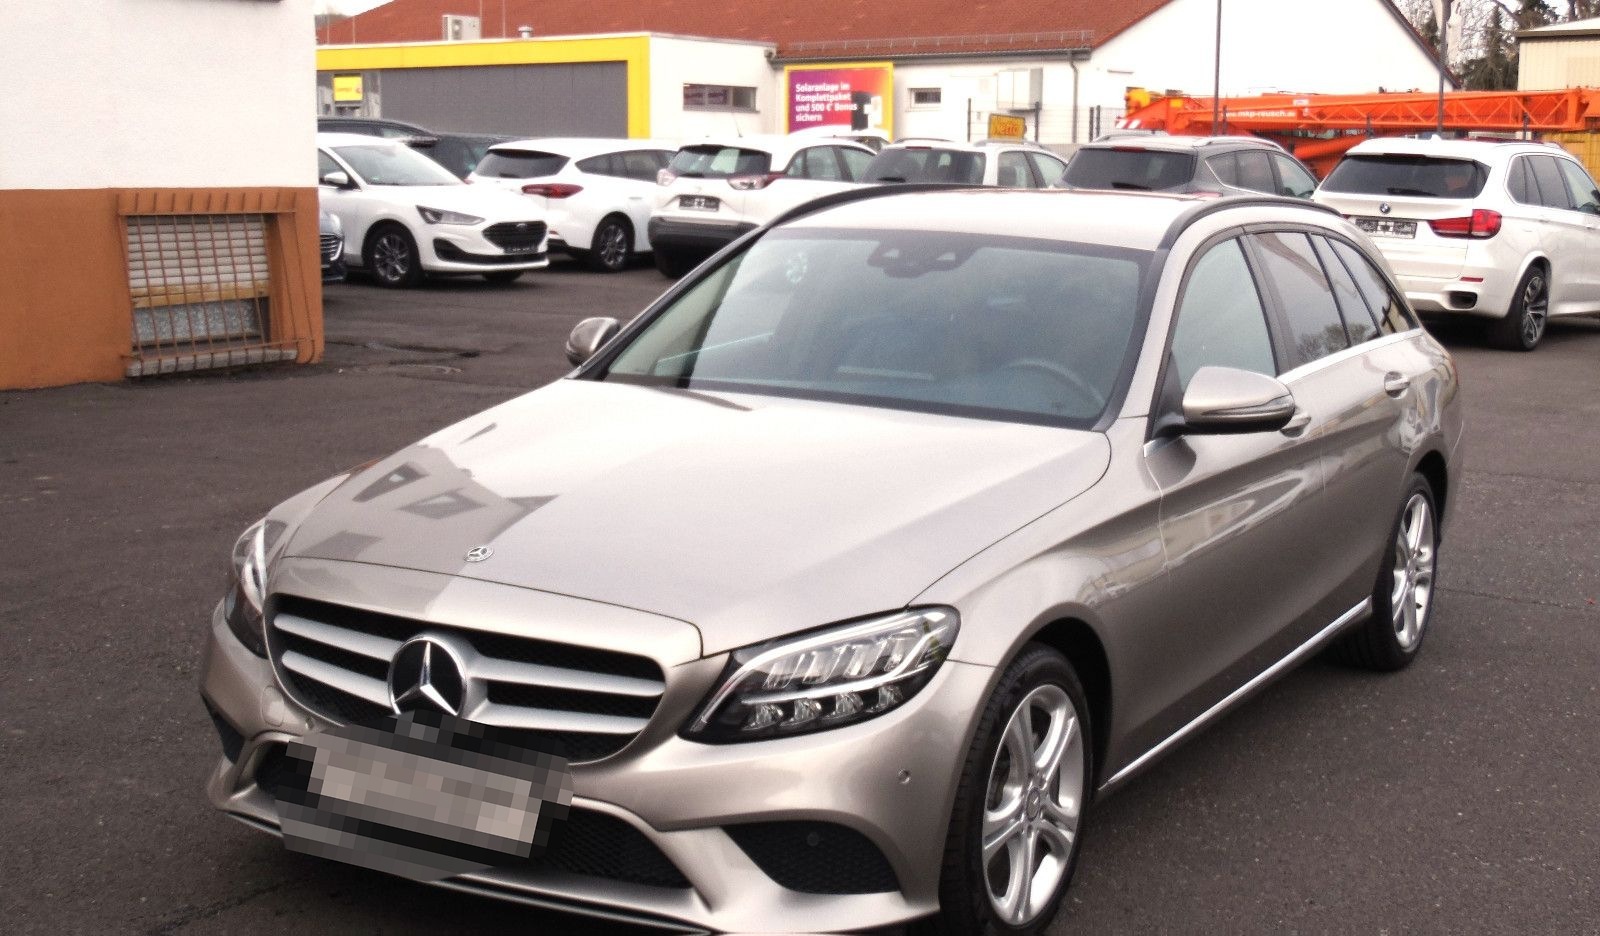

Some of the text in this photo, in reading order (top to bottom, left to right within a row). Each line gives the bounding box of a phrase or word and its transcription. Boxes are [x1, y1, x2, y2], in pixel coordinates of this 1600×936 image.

[796, 82, 850, 93] Solaranlage im
[796, 94, 852, 102] Komplettpaket
[795, 103, 810, 112] und
[811, 103, 825, 112] 500
[834, 103, 858, 111] Bonus
[795, 113, 823, 122] sichern
